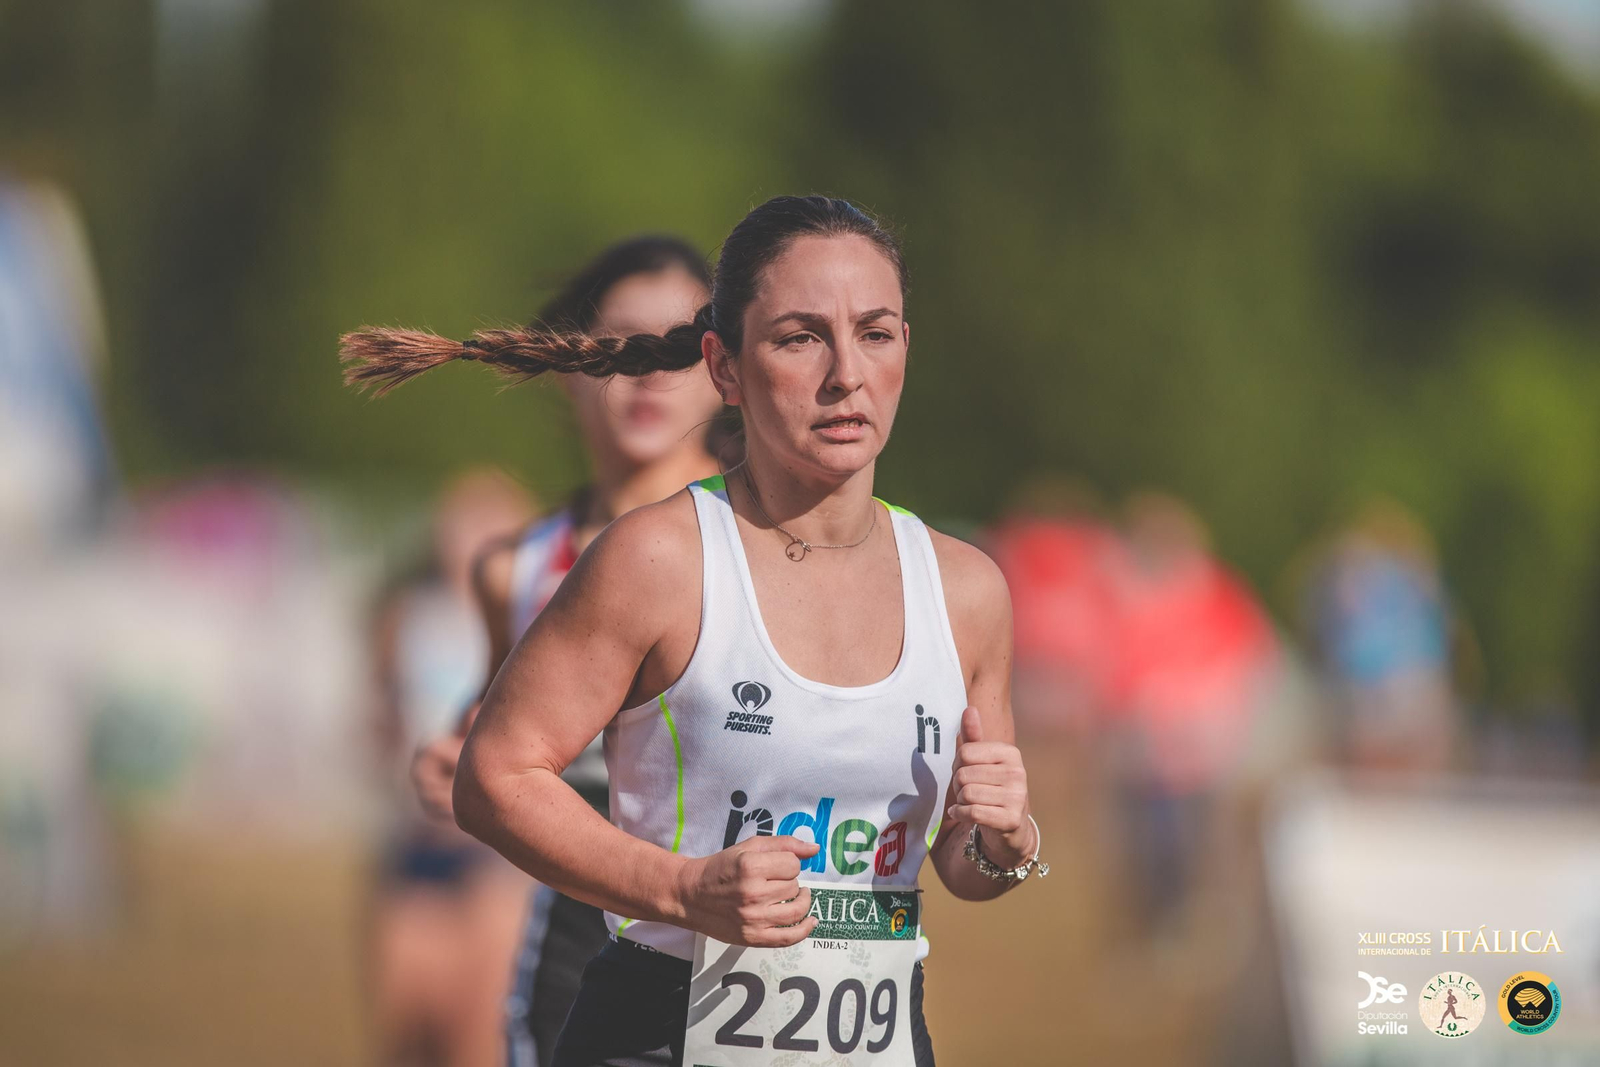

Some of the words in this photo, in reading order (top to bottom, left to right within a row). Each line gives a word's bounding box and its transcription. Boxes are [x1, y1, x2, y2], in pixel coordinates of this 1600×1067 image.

[726, 711, 774, 725] SPORTING
[724, 720, 771, 735] PURSUITS.
[806, 891, 880, 923] ÁLICA
[813, 940, 848, 950] INDEA-2
[715, 971, 898, 1054] 2209
